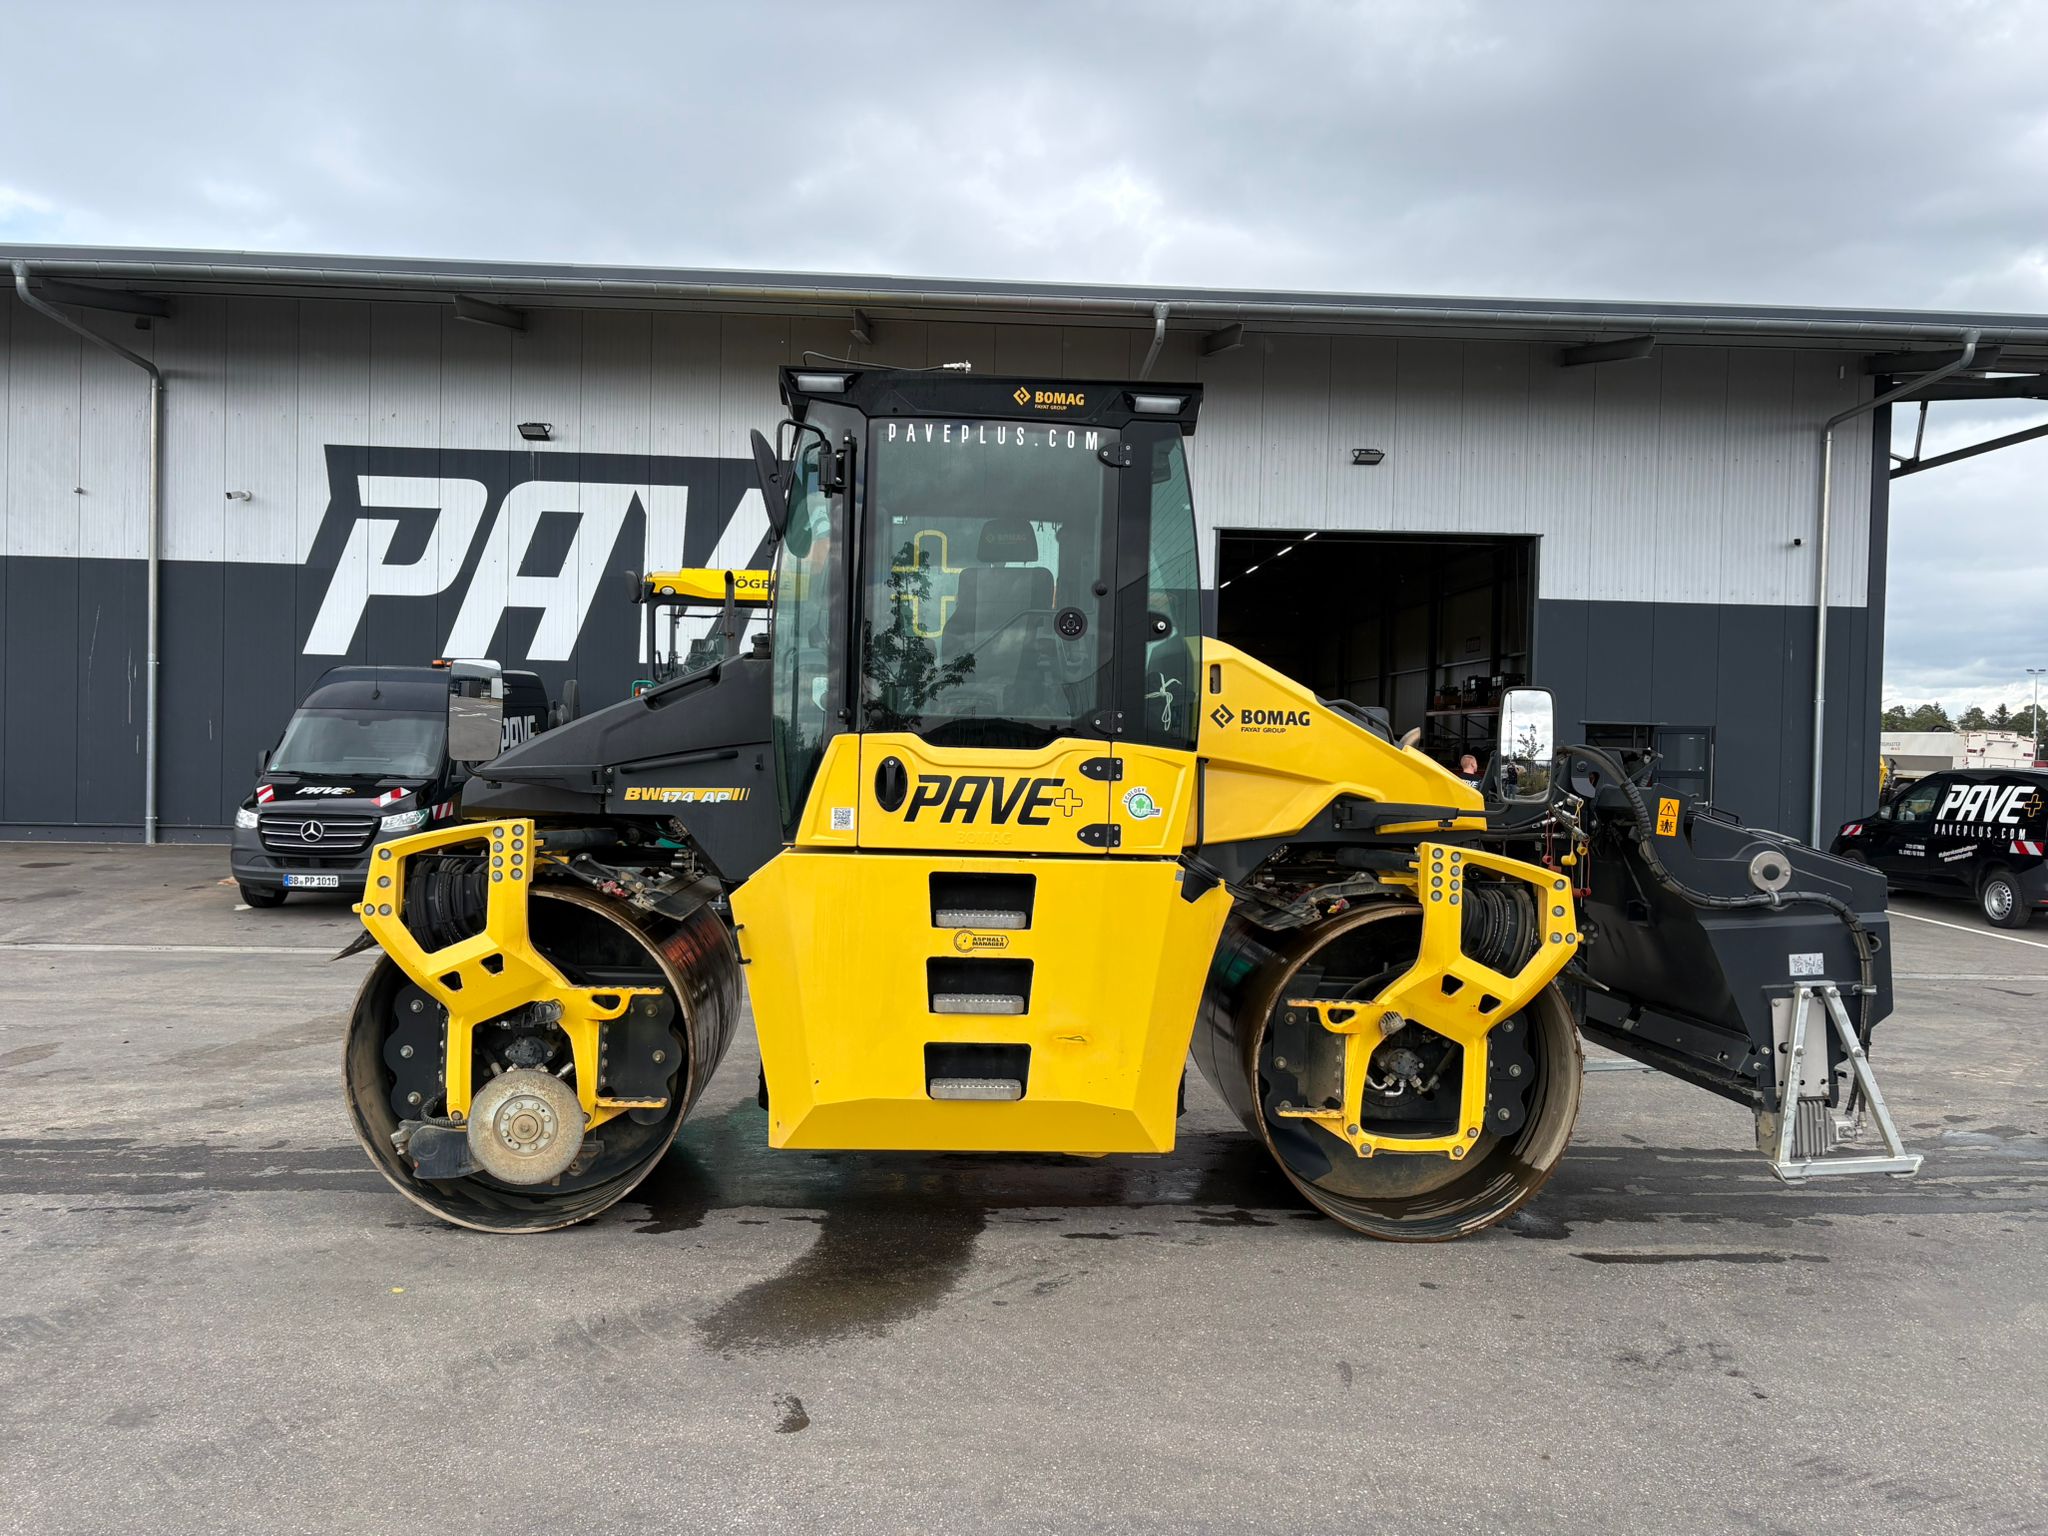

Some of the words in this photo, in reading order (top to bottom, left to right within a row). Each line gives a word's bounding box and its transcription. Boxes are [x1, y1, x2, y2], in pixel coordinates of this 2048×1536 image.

[1035, 391, 1085, 406] BOMAG
[888, 423, 1098, 450] PAVEPLUS.COM
[1241, 709, 1311, 727] BOMAG
[1934, 823, 2026, 841] PAVEPLUS.COM
